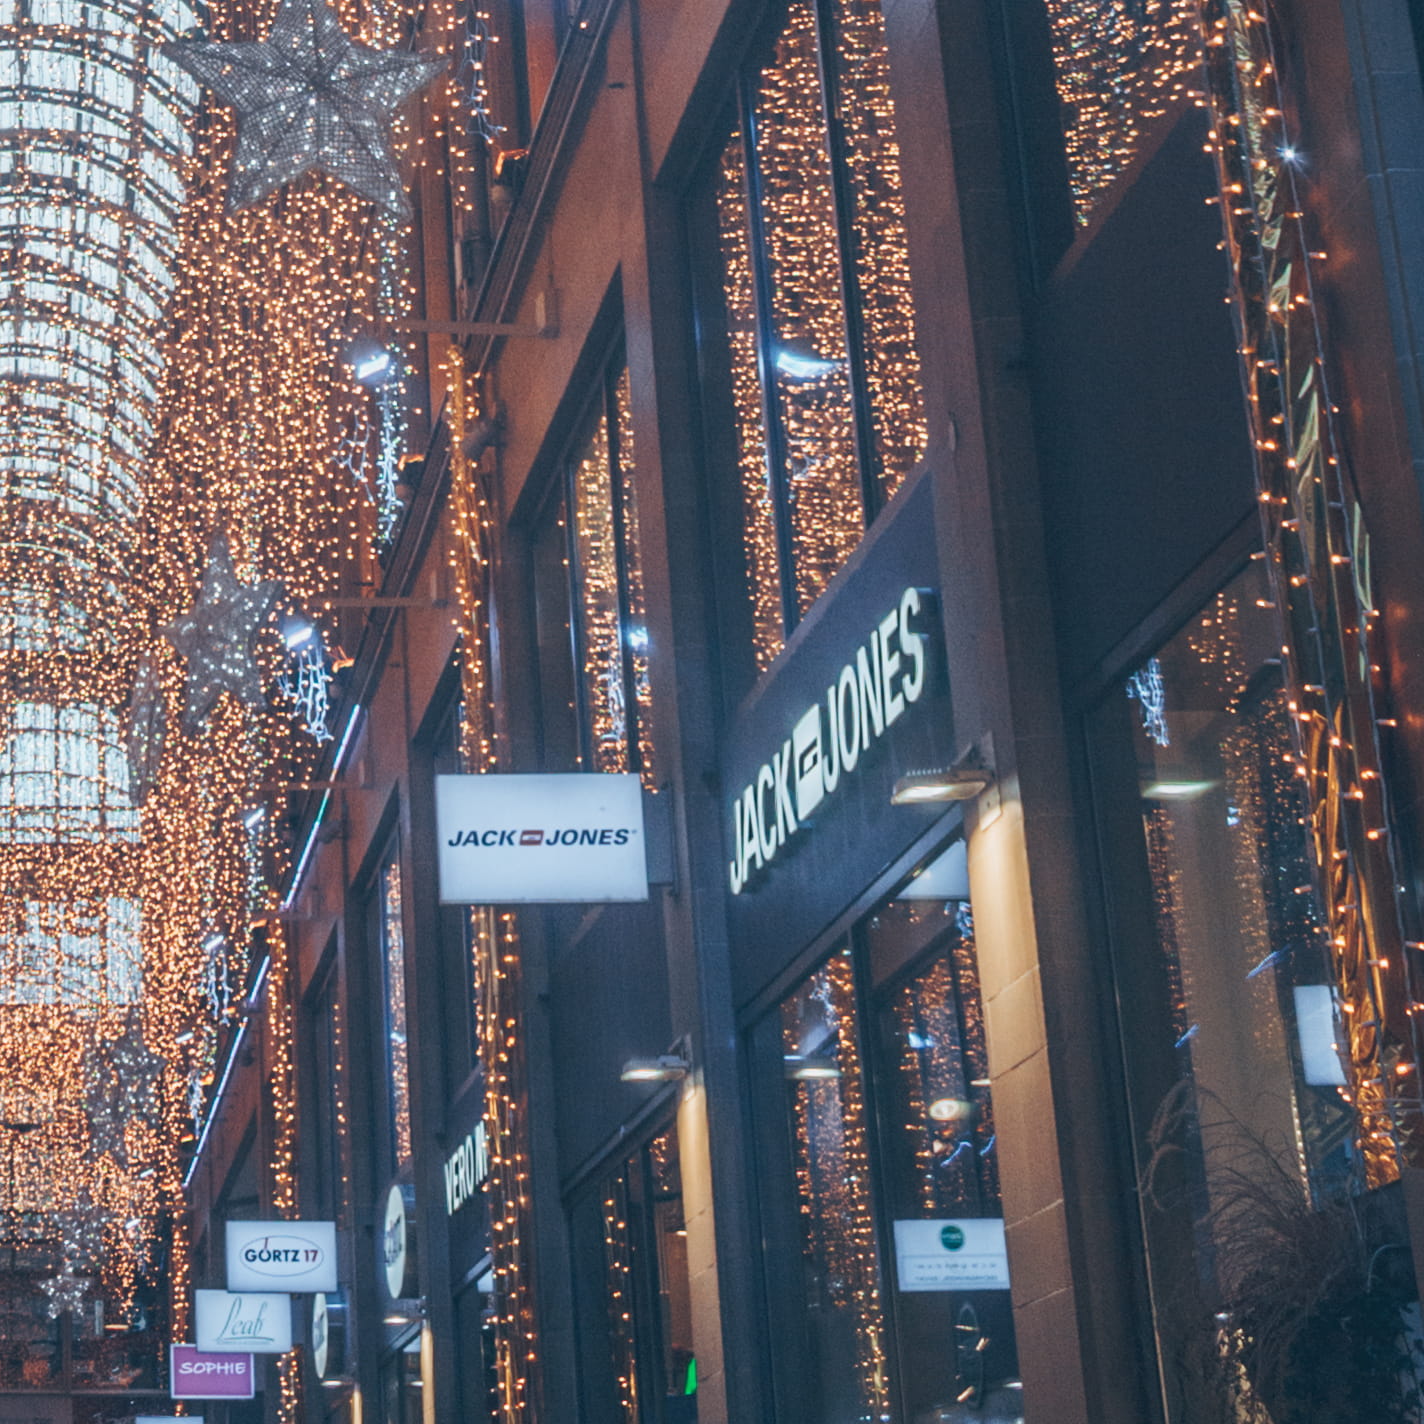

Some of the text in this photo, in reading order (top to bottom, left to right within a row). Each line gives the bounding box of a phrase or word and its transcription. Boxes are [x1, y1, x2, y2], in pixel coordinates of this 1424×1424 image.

[729, 587, 924, 895] JACK JONES
[448, 829, 630, 847] JACK JONES
[444, 1135, 474, 1216] VERO
[304, 1249, 319, 1263] 17
[178, 1361, 247, 1375] SOPHIE
